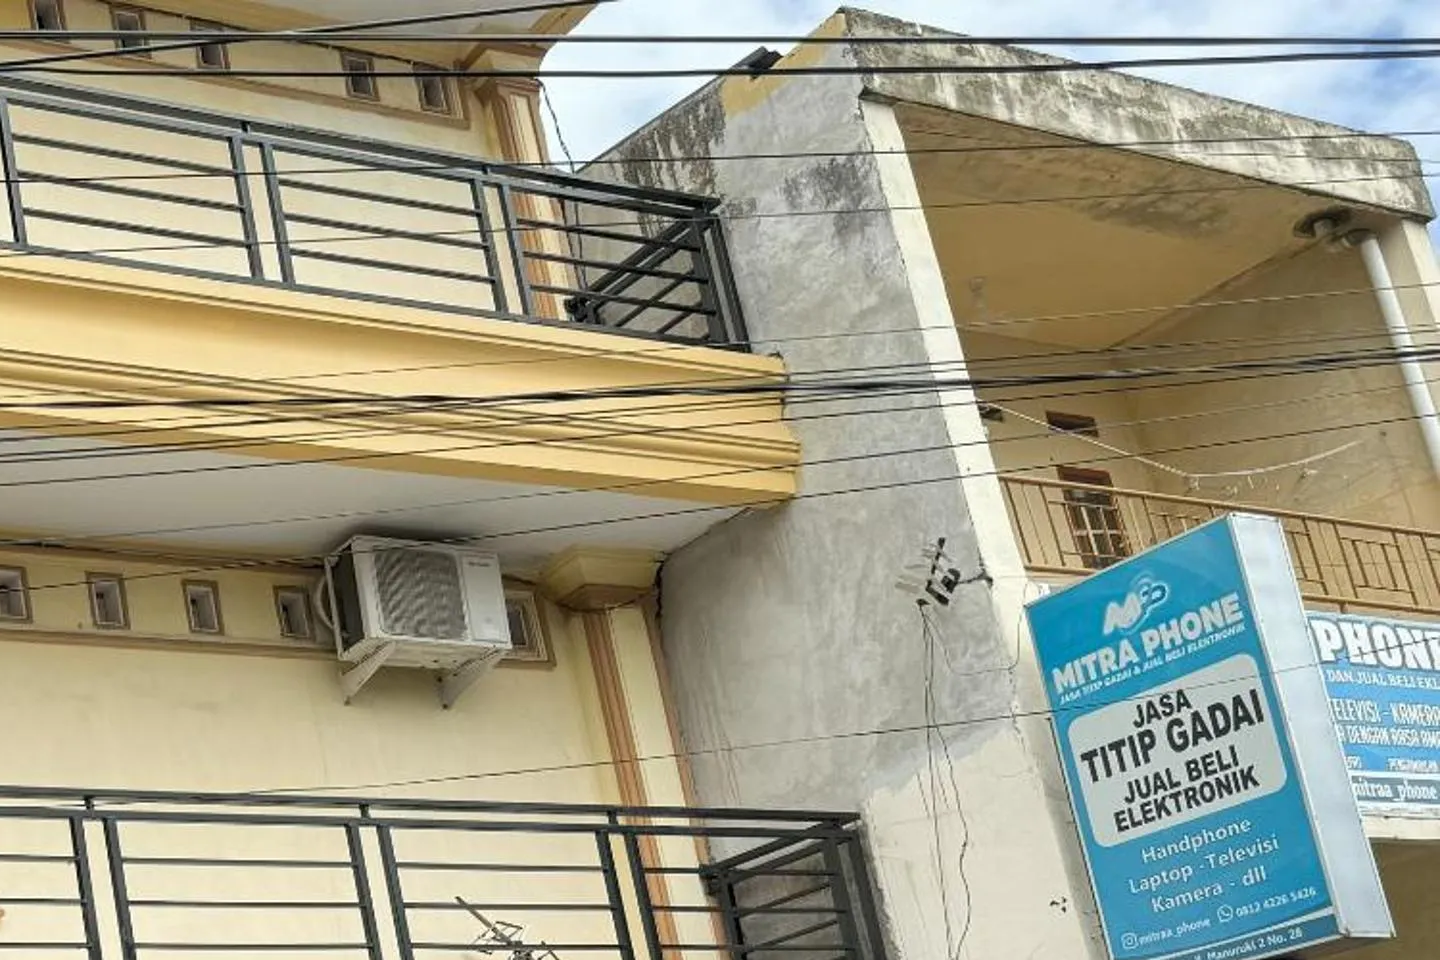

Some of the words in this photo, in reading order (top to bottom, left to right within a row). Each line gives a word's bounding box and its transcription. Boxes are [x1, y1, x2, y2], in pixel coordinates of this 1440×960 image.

[1052, 638, 1139, 692] MITRA
[1141, 592, 1244, 655] PHONE
[1132, 689, 1191, 728] JASA
[1330, 698, 1381, 723] ELEVISI
[1080, 729, 1156, 784] TITIP
[1166, 689, 1264, 753] GADAI
[1124, 768, 1181, 804] JUAL
[1185, 745, 1240, 782] BELI
[1114, 765, 1260, 832] ELEKTRONIK
[1141, 819, 1252, 863] Handphone
[1128, 864, 1193, 895] Laptop
[1151, 881, 1223, 912] Kamera
[1242, 865, 1266, 888] dll
